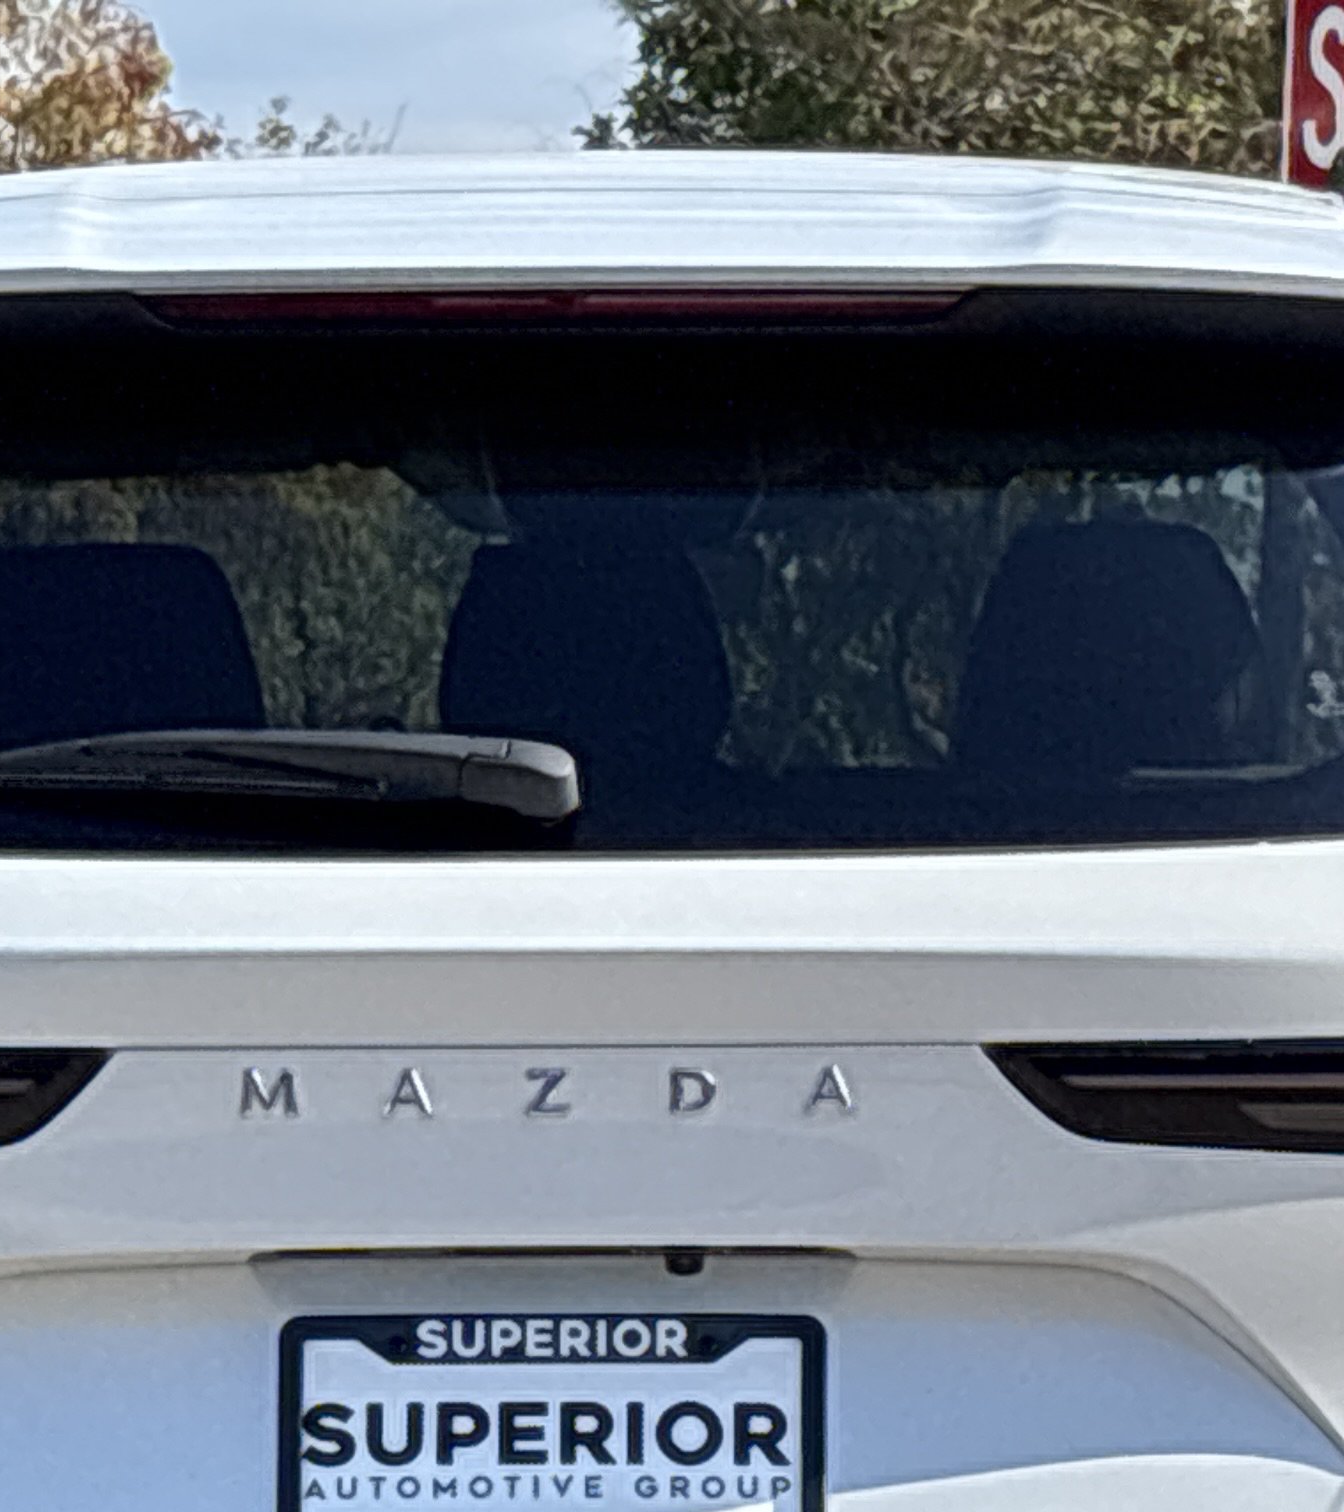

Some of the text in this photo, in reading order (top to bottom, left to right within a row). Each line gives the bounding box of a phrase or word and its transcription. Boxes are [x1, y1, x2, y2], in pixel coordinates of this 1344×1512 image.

[240, 1064, 856, 1118] MAZDA
[416, 1319, 688, 1358] SUPERIOR
[301, 1402, 791, 1467] SUPERIOR
[304, 1475, 792, 1499] AUTOMOTIVE GROUP
